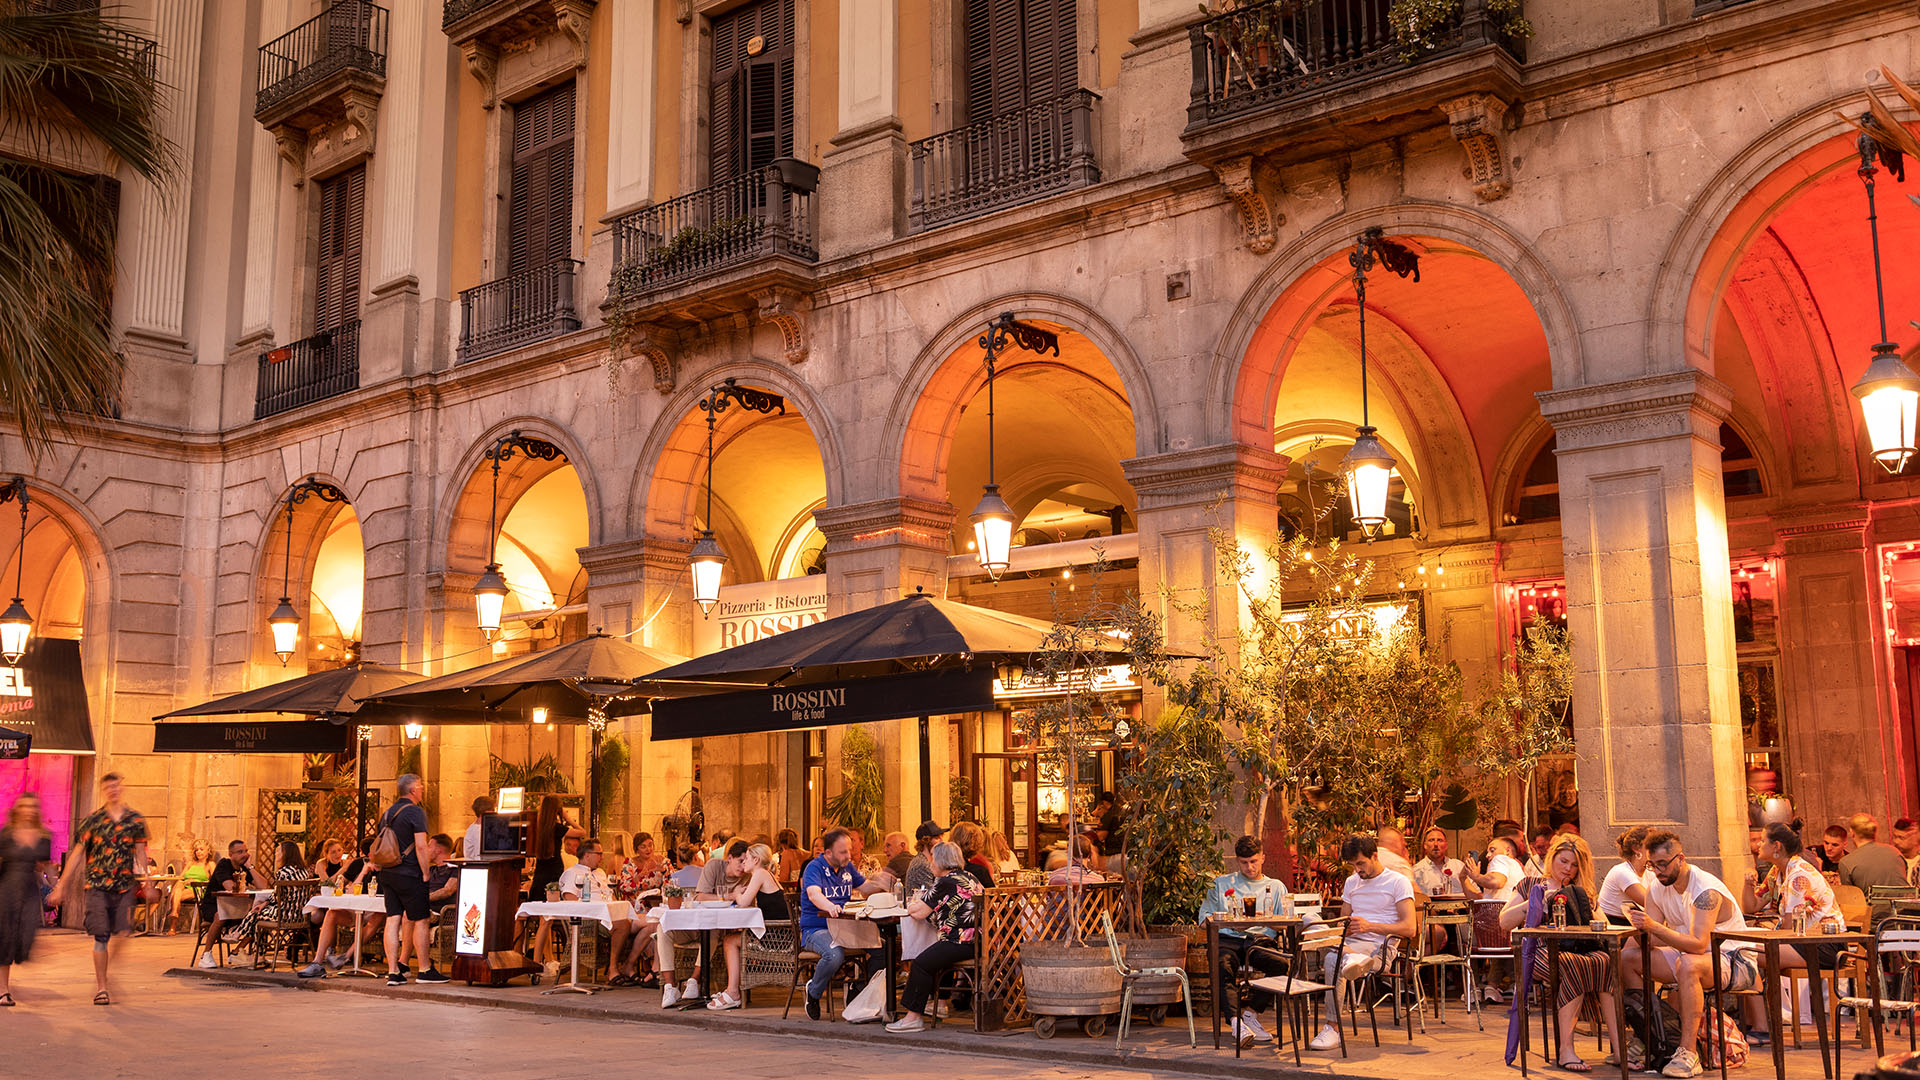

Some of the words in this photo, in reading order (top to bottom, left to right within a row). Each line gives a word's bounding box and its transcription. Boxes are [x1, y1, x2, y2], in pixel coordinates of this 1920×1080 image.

[720, 599, 765, 616] Pizzeria
[772, 687, 847, 712] ROSSINI
[792, 710, 802, 720] life
[811, 707, 825, 719] food
[224, 727, 266, 741] ROSSINI
